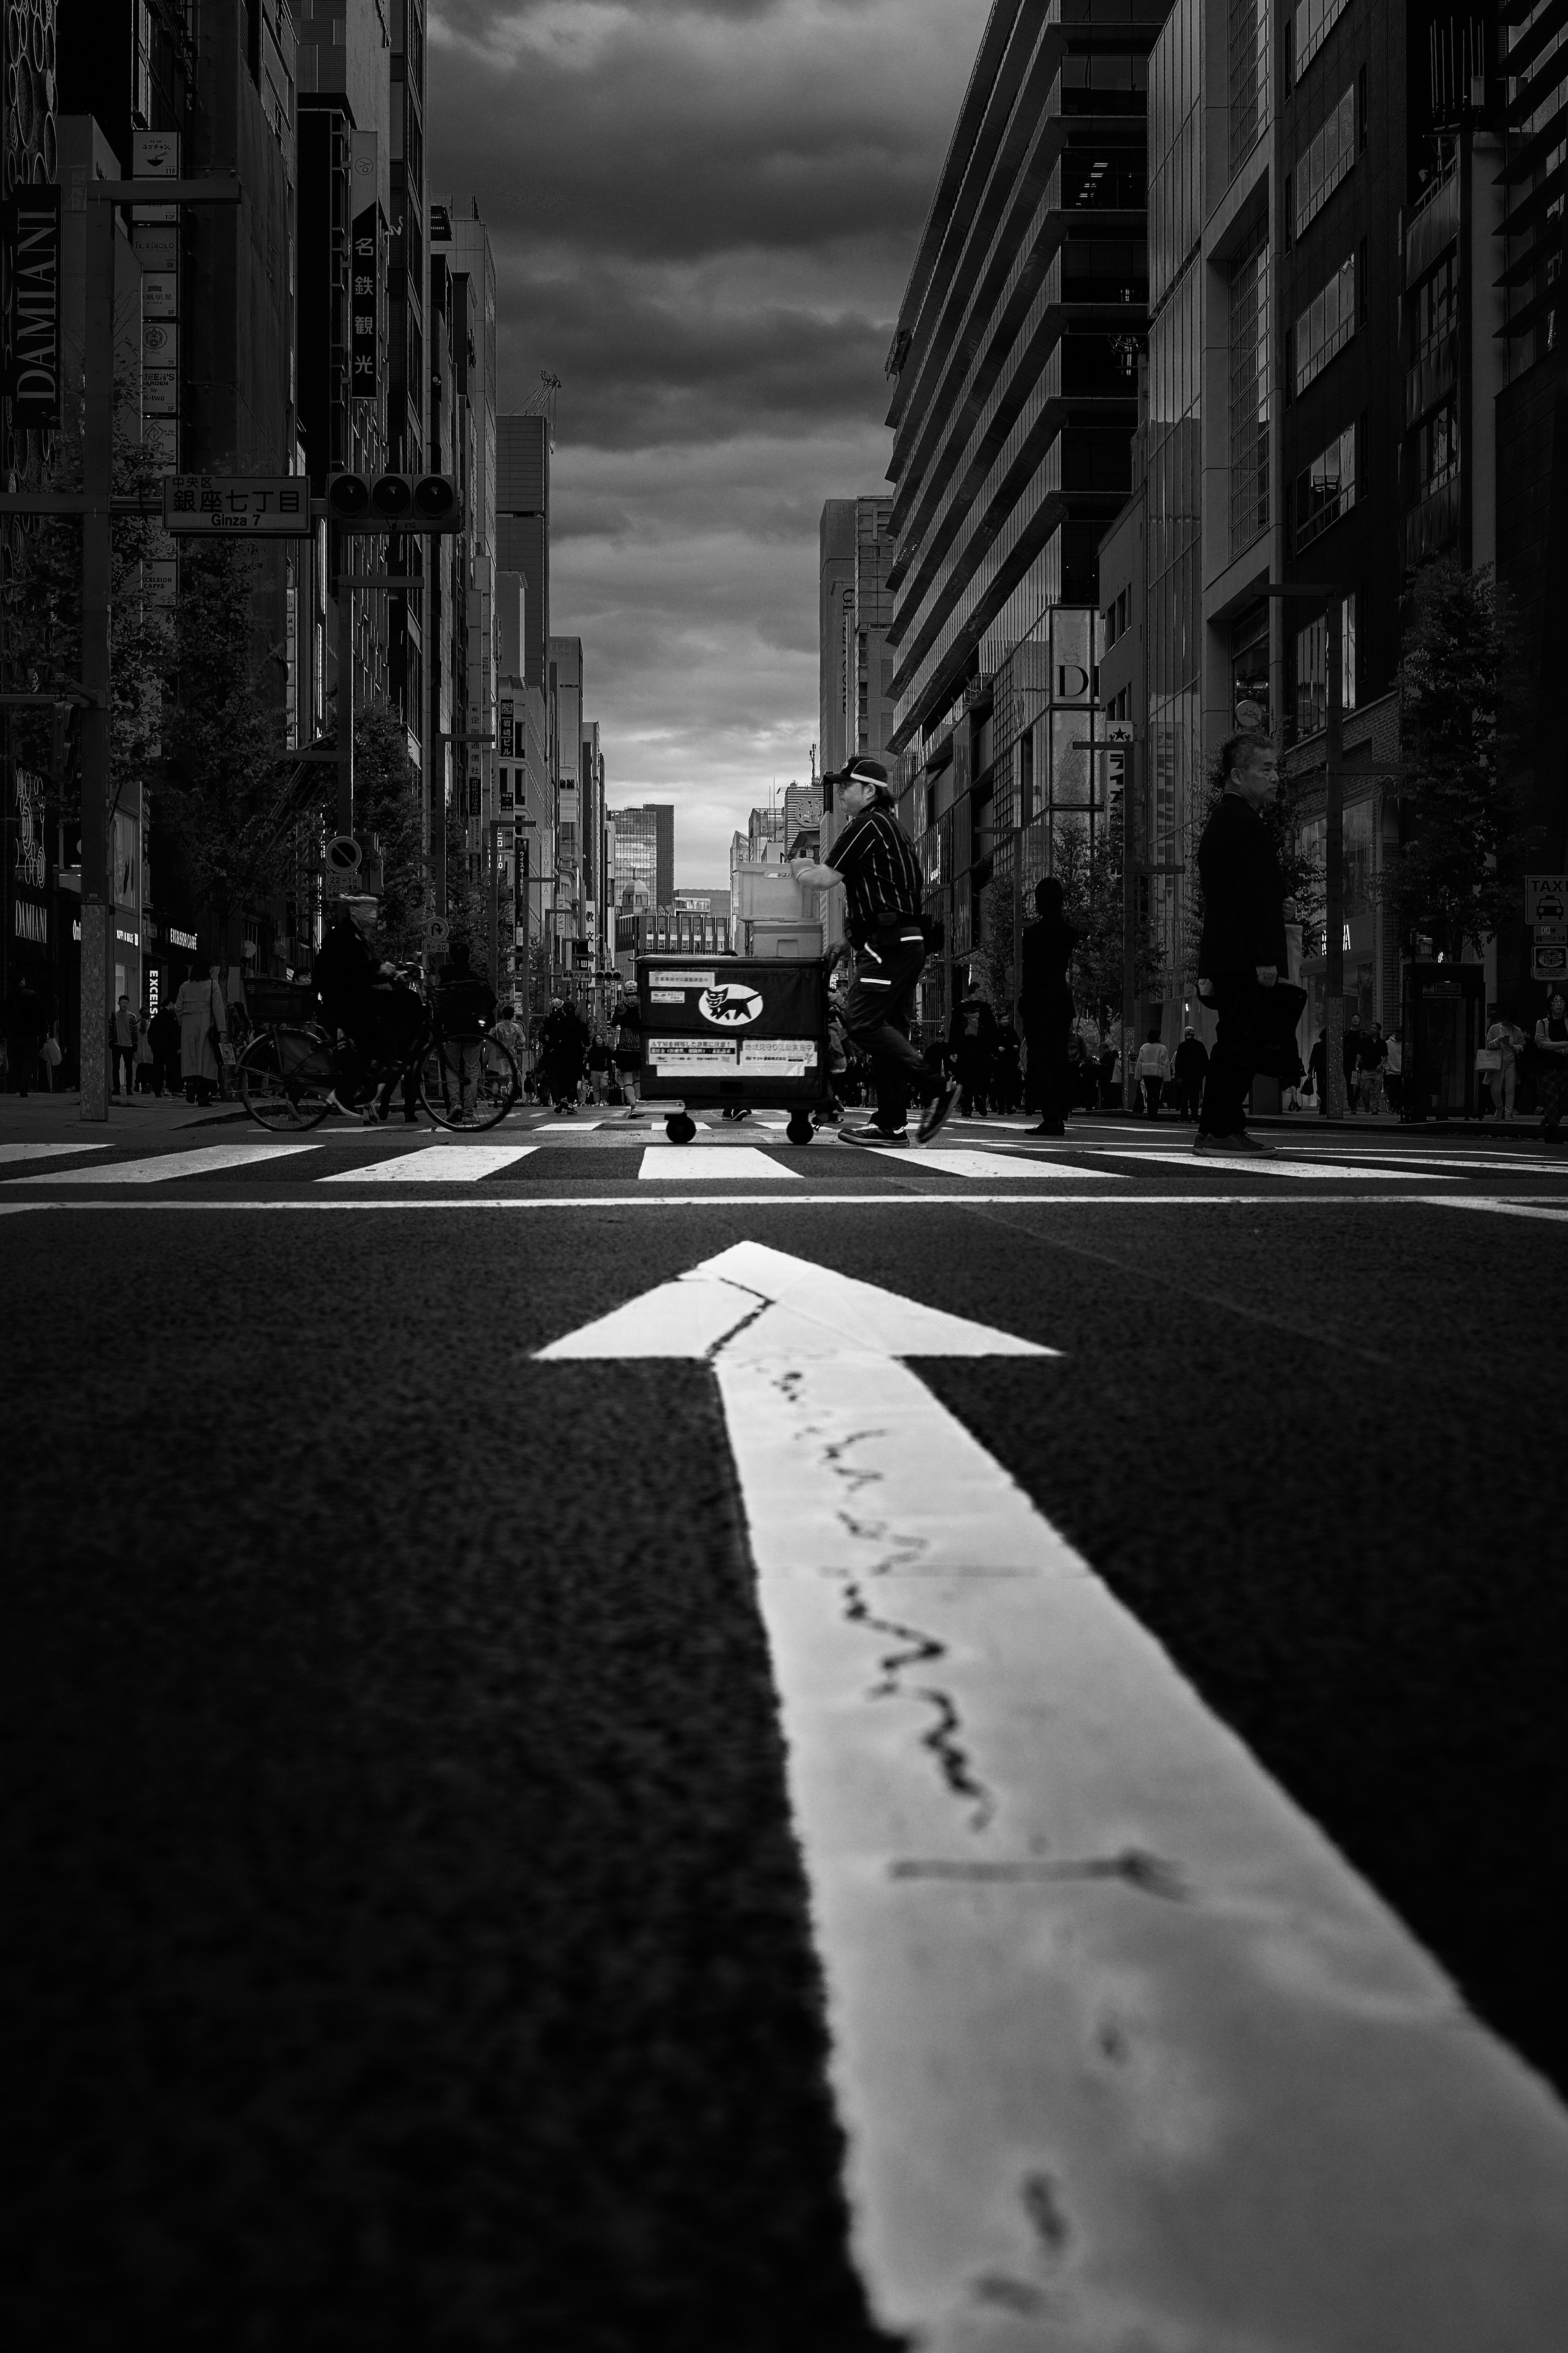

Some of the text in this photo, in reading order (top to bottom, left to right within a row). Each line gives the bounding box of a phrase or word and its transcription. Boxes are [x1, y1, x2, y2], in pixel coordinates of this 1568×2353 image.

[16, 207, 56, 402] DAMIANI
[354, 238, 374, 374] 名鉄観光
[173, 477, 212, 488] 中央区
[173, 489, 299, 513] 銀座七丁目
[212, 514, 261, 526] Ginza 7
[1531, 880, 1568, 892] TAXI
[15, 900, 47, 943] DAMIANI
[170, 928, 197, 951] EXCELSIOR CAFFÉ
